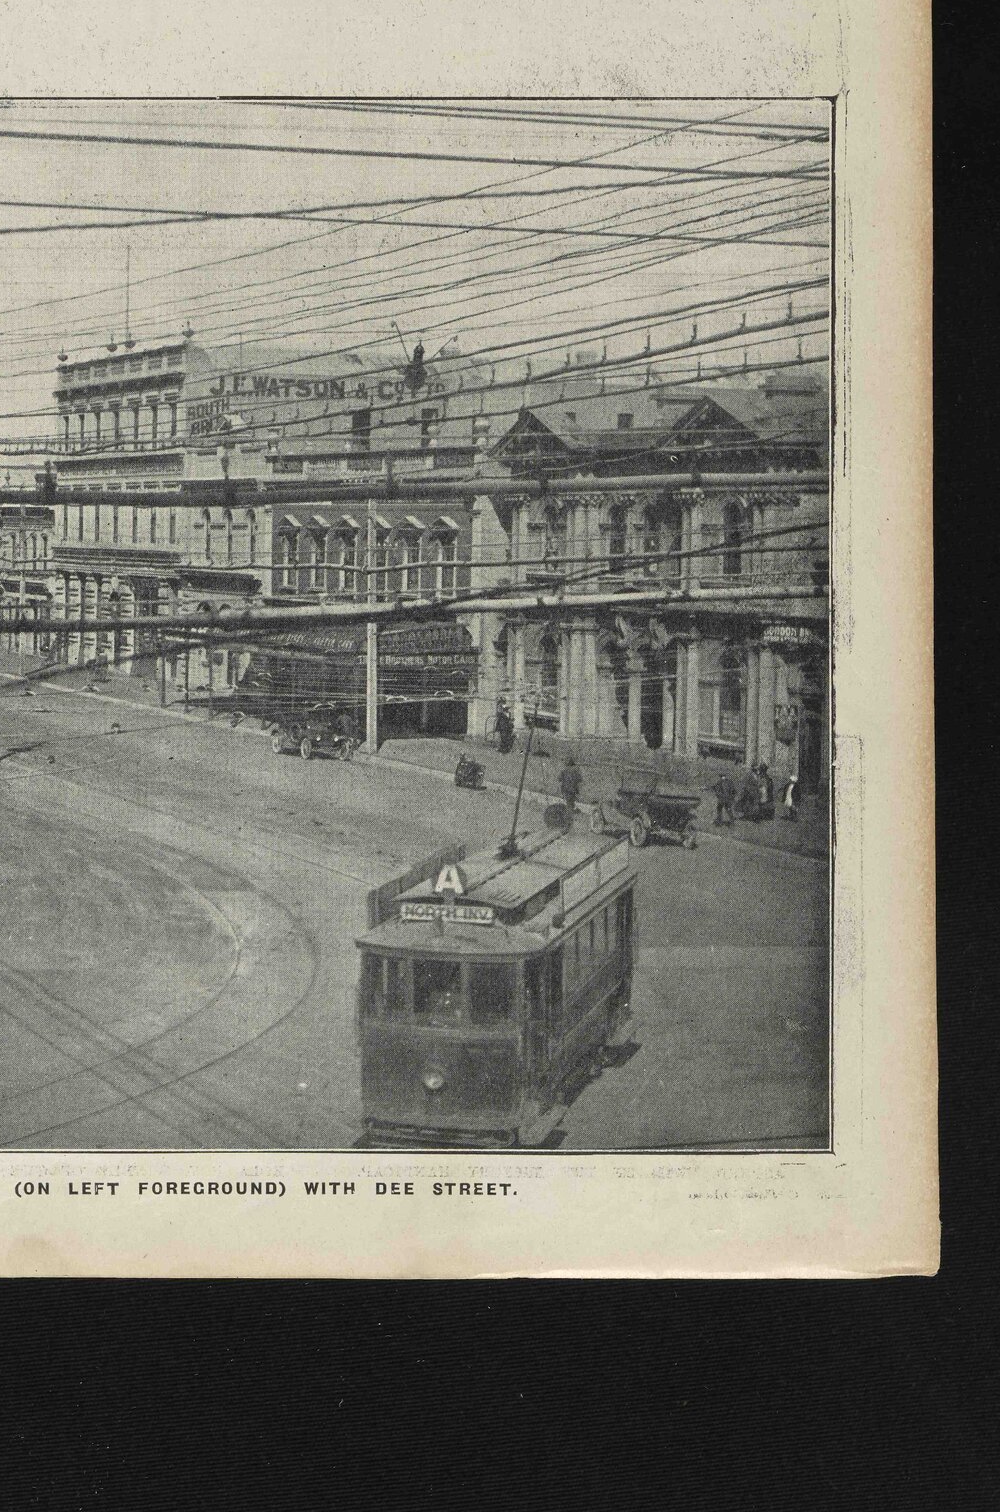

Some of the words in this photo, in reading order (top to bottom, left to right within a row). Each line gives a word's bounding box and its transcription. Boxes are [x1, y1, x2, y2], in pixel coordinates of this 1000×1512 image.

[435, 864, 464, 894] A
[15, 1181, 50, 1198] (ON
[69, 1182, 119, 1195] LEFT
[138, 1181, 286, 1198] FOREGROUND)
[304, 1182, 355, 1195] WITH
[376, 1182, 415, 1195] DEE
[433, 1182, 518, 1195] STREET.
